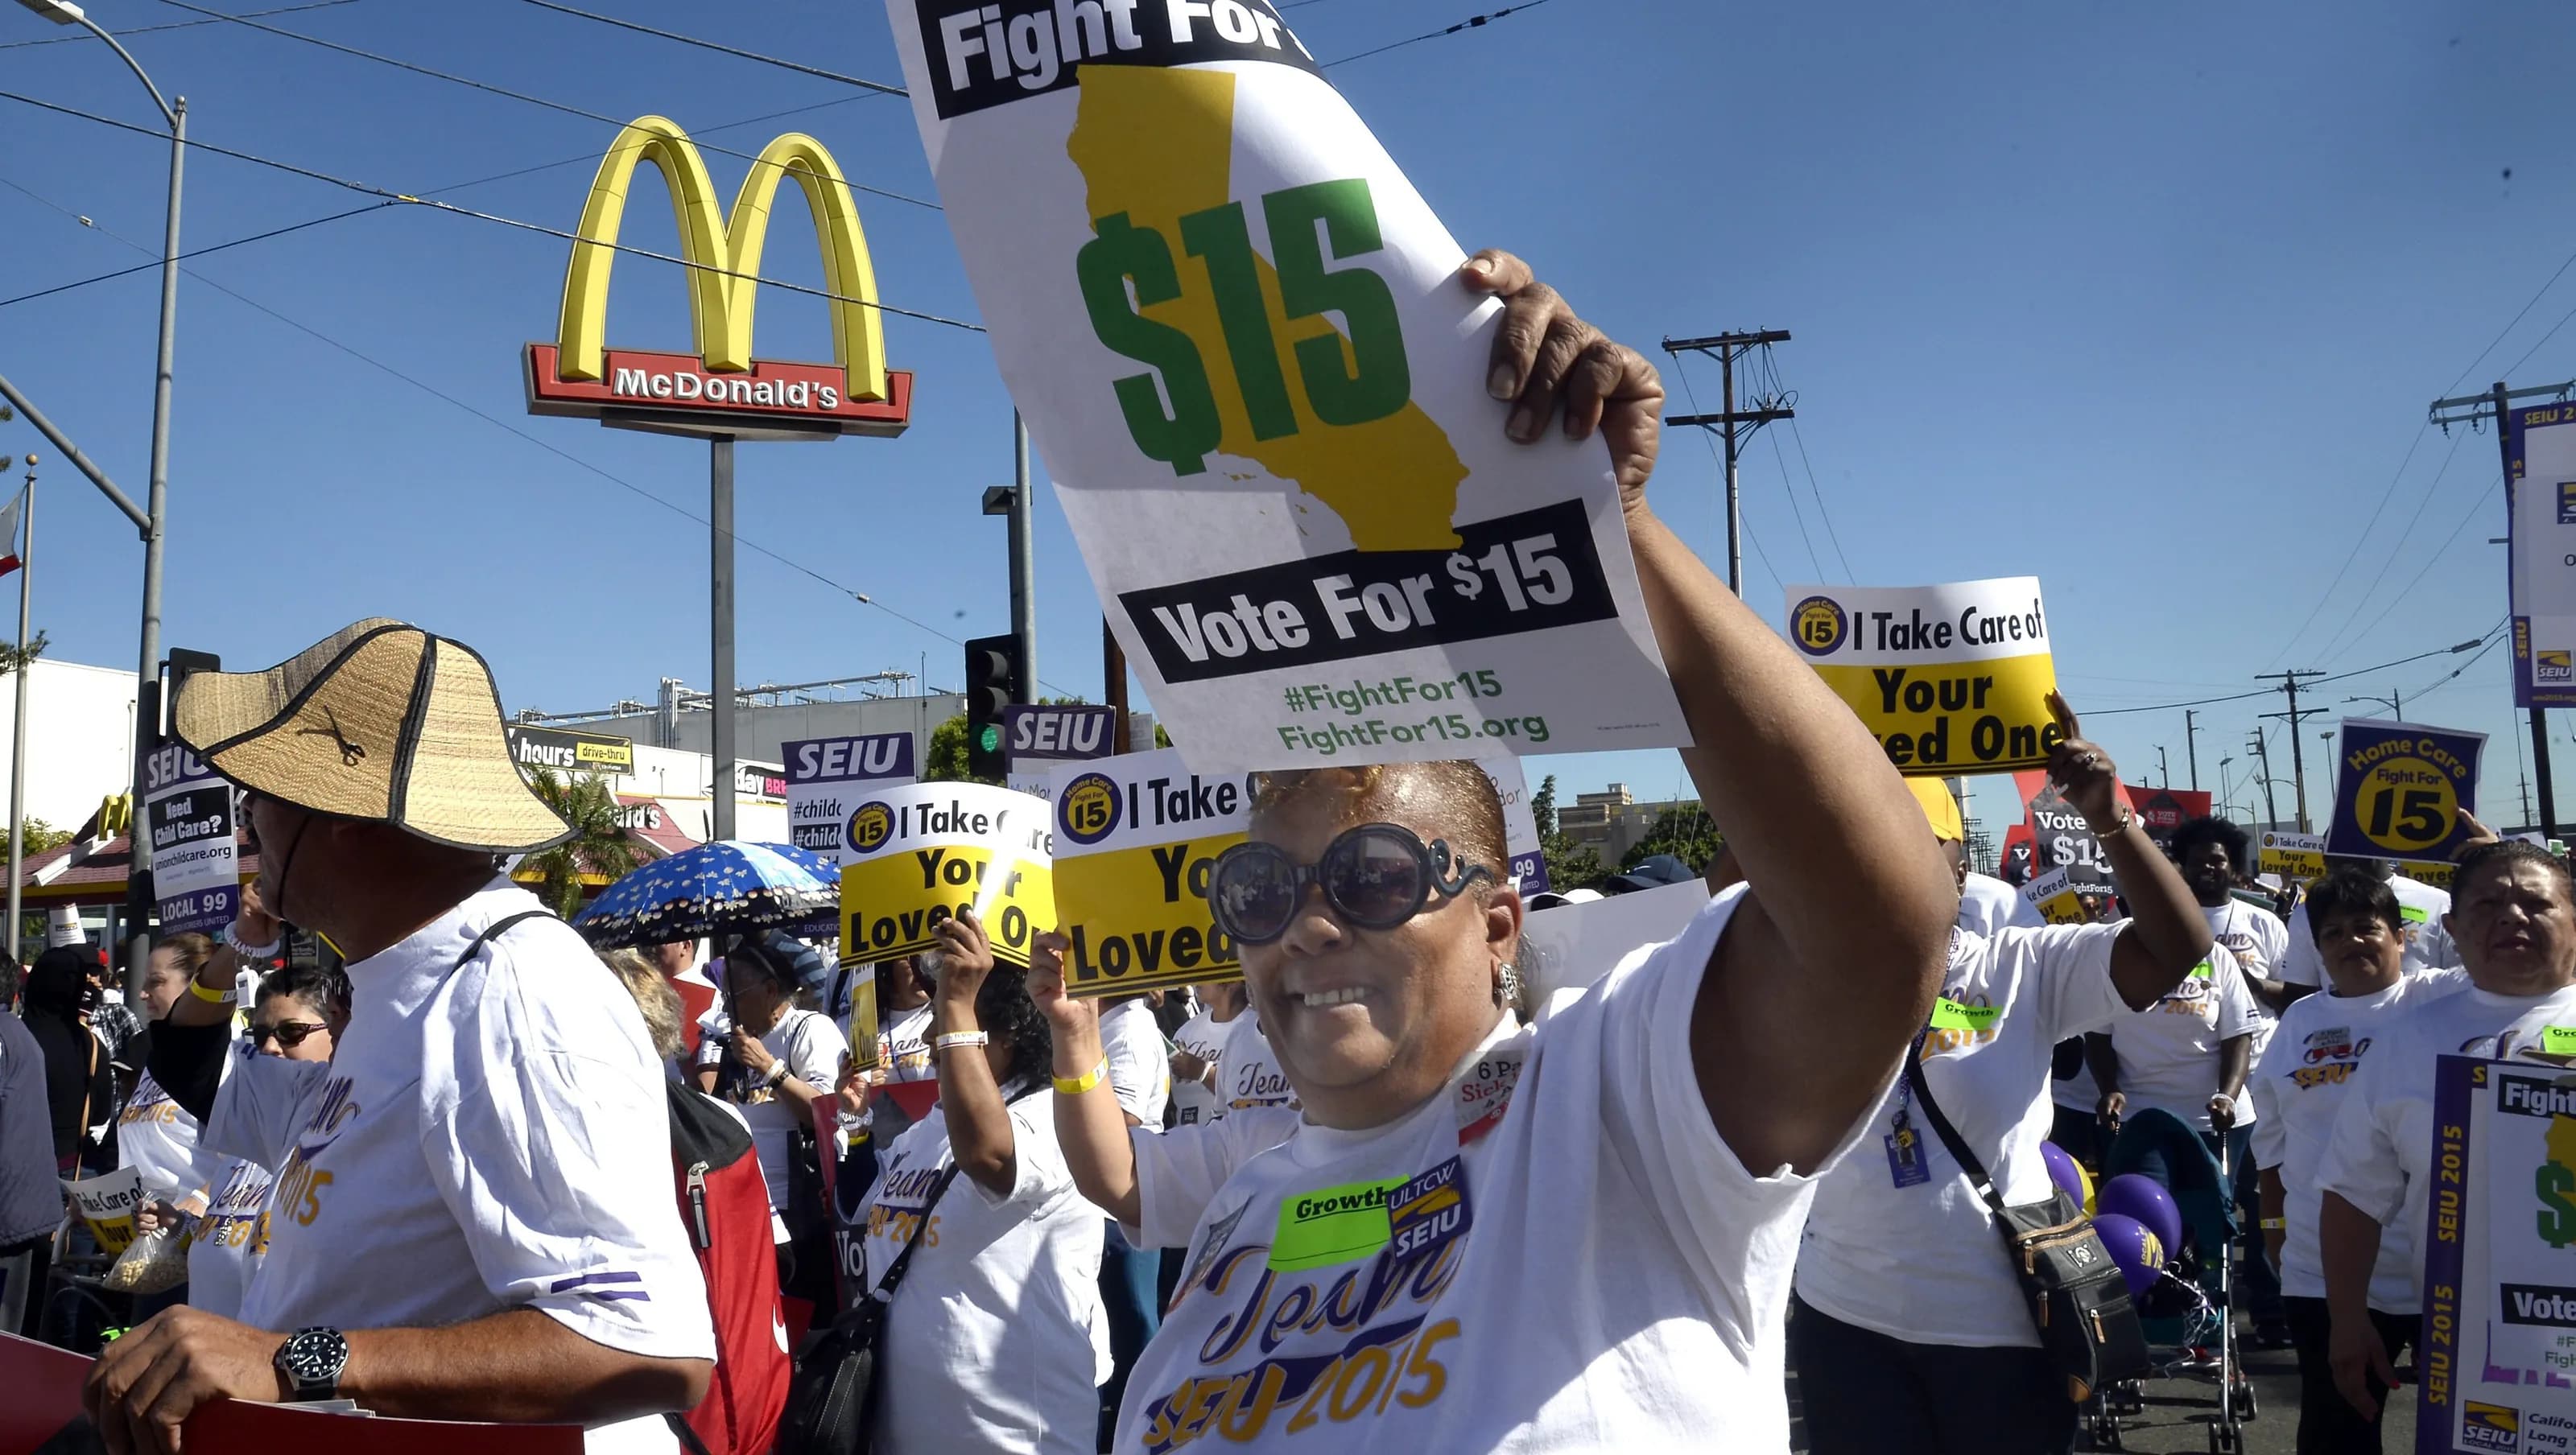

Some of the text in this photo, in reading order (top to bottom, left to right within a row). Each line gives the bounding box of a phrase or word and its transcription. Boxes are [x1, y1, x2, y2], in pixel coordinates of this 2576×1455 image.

[939, 0, 1143, 91] Fight
[1166, 0, 1282, 51] For
[1075, 178, 1411, 476] $15
[613, 367, 839, 410] McDonald's
[2524, 409, 2559, 425] SEIU
[1152, 532, 1575, 664] Vote For $15
[1805, 620, 1833, 643] 15
[1853, 598, 2044, 651] I Take Care of
[2516, 621, 2529, 659] SEIU
[2539, 667, 2570, 678] SEIU
[1285, 670, 1504, 718] #FightFor15
[1873, 668, 1992, 714] Your
[1014, 712, 1105, 752] SEIU
[1278, 711, 1550, 756] FightFor15.org
[1876, 715, 2065, 765] ed One
[519, 737, 576, 768] hours
[582, 745, 625, 760] drive-thru
[795, 736, 901, 779] SEIU
[2347, 738, 2467, 779] Home Care
[1064, 777, 1113, 799] Home Care
[2376, 768, 2442, 785] Fight For
[165, 797, 192, 820] Need
[1075, 801, 1107, 830] 15
[1129, 782, 1139, 830] I
[1147, 774, 1238, 826] Take
[2368, 787, 2446, 843] 15
[155, 814, 222, 847] Child Care?
[859, 820, 884, 843] 15
[900, 800, 1053, 855] I Take Cre
[2034, 811, 2087, 831] Vote
[2278, 850, 2306, 863] Your
[2279, 836, 2297, 848] Take
[2297, 839, 2318, 851] Care
[1515, 858, 1535, 877] 99
[2037, 882, 2058, 897] Care
[2058, 872, 2068, 888] of
[2298, 863, 2324, 876] One
[162, 892, 228, 922] LOCAL 99
[1945, 1004, 1994, 1018] Growth
[1478, 1061, 1492, 1080] 6
[2440, 1124, 2462, 1185] 2015
[1296, 1185, 1392, 1219] Growth
[1390, 1161, 1456, 1210] ULTCW
[890, 1210, 942, 1247] 205
[1395, 1203, 1462, 1258] SEIU
[2437, 1190, 2460, 1244] SEIU
[835, 1230, 866, 1277] Vo
[2431, 1284, 2454, 1346] 2015
[2512, 1291, 2576, 1321] Vote
[2428, 1351, 2450, 1407] SEIU
[2463, 1424, 2516, 1446] SEIU
[2529, 1413, 2576, 1430] Califo
[2528, 1429, 2569, 1449] Long
